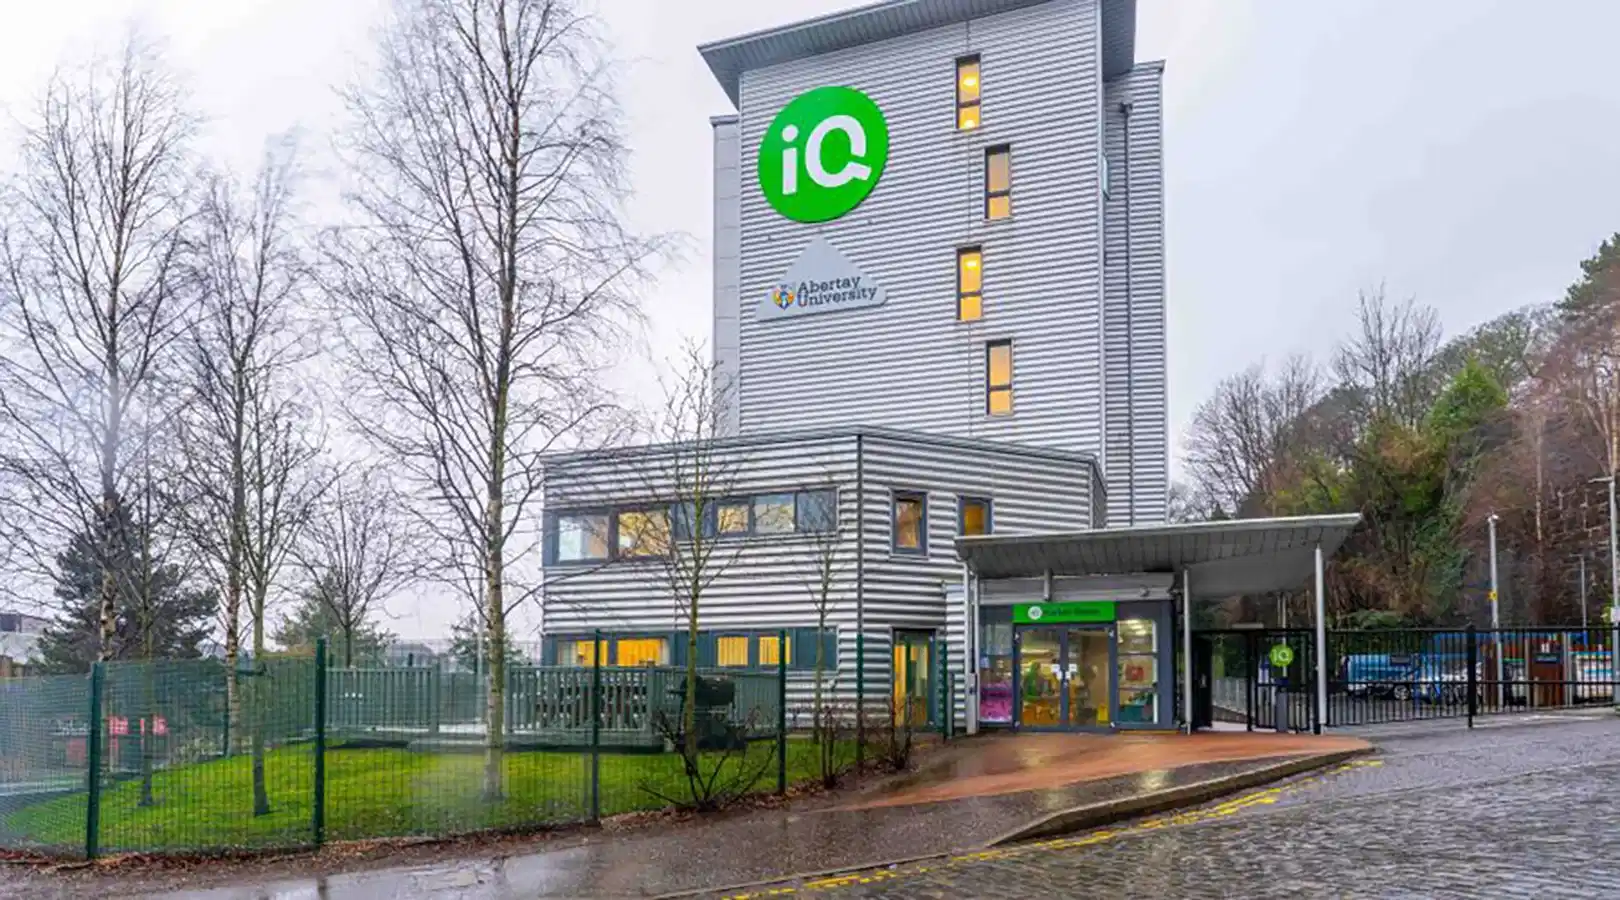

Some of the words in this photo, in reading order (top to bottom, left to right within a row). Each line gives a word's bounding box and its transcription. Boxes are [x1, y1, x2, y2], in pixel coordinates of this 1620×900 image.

[782, 114, 872, 195] iQ
[797, 276, 861, 296] Abertay
[796, 287, 877, 307] University
